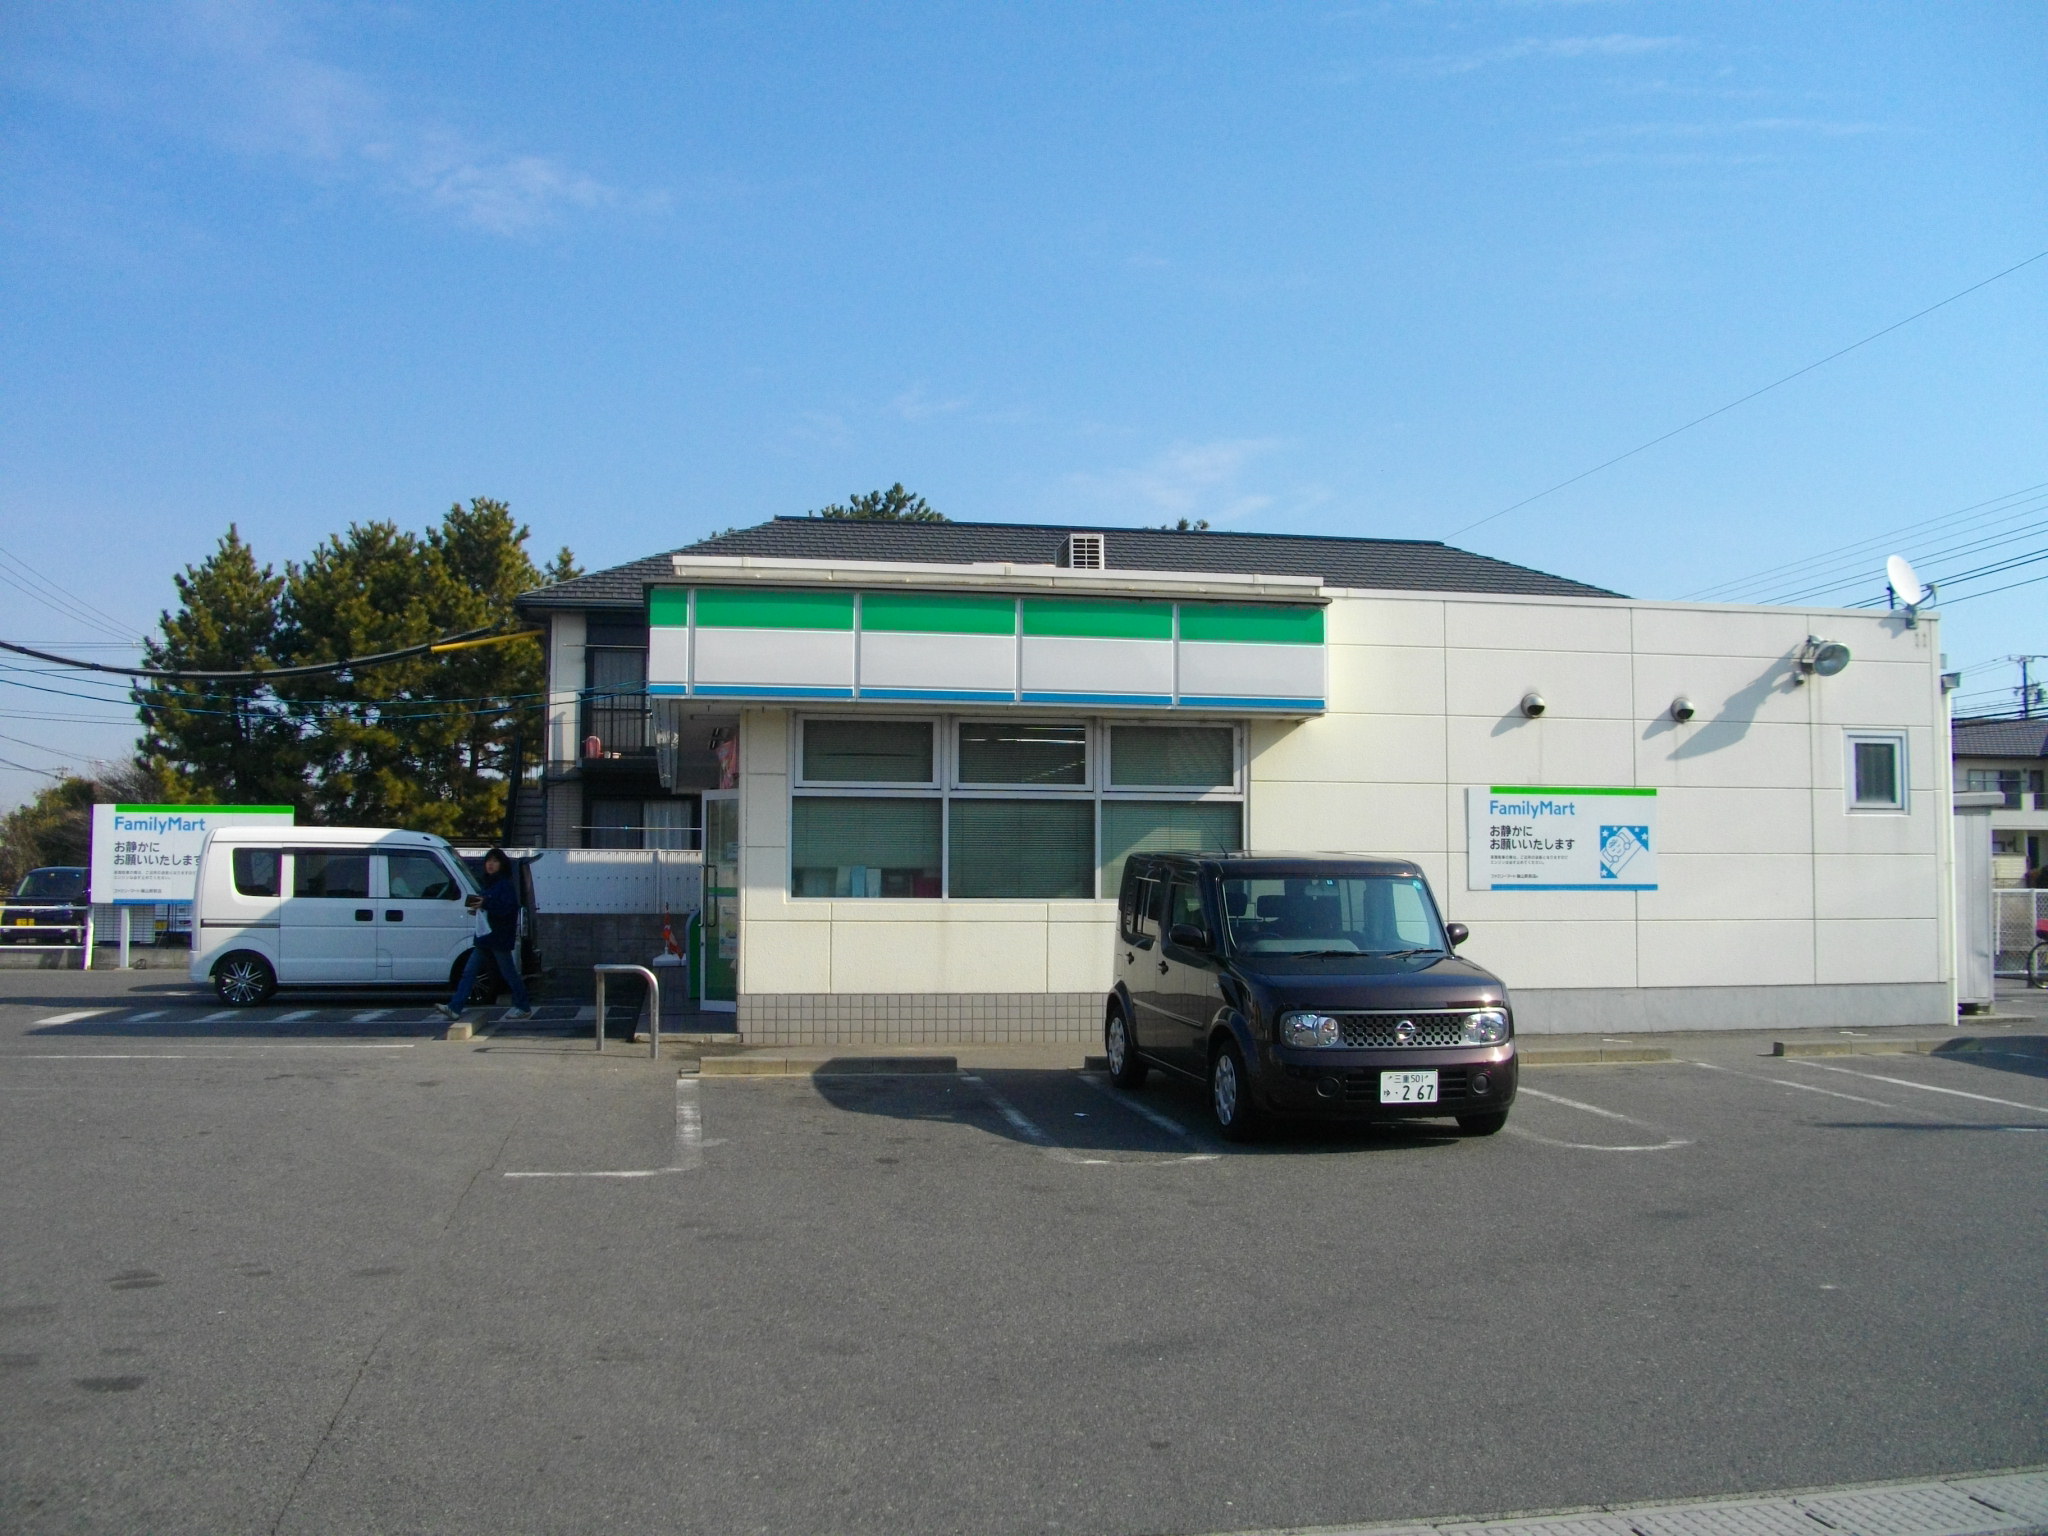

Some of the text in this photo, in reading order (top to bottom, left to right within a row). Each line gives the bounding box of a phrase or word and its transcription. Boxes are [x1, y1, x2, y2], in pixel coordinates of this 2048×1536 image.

[1489, 800, 1575, 819] FamilyMart
[114, 816, 205, 834] FamilyMart
[1489, 825, 1533, 837] お静かに
[113, 841, 160, 853] お静かに
[1489, 838, 1575, 851] お願いいたします
[1410, 1074, 1424, 1083] 501
